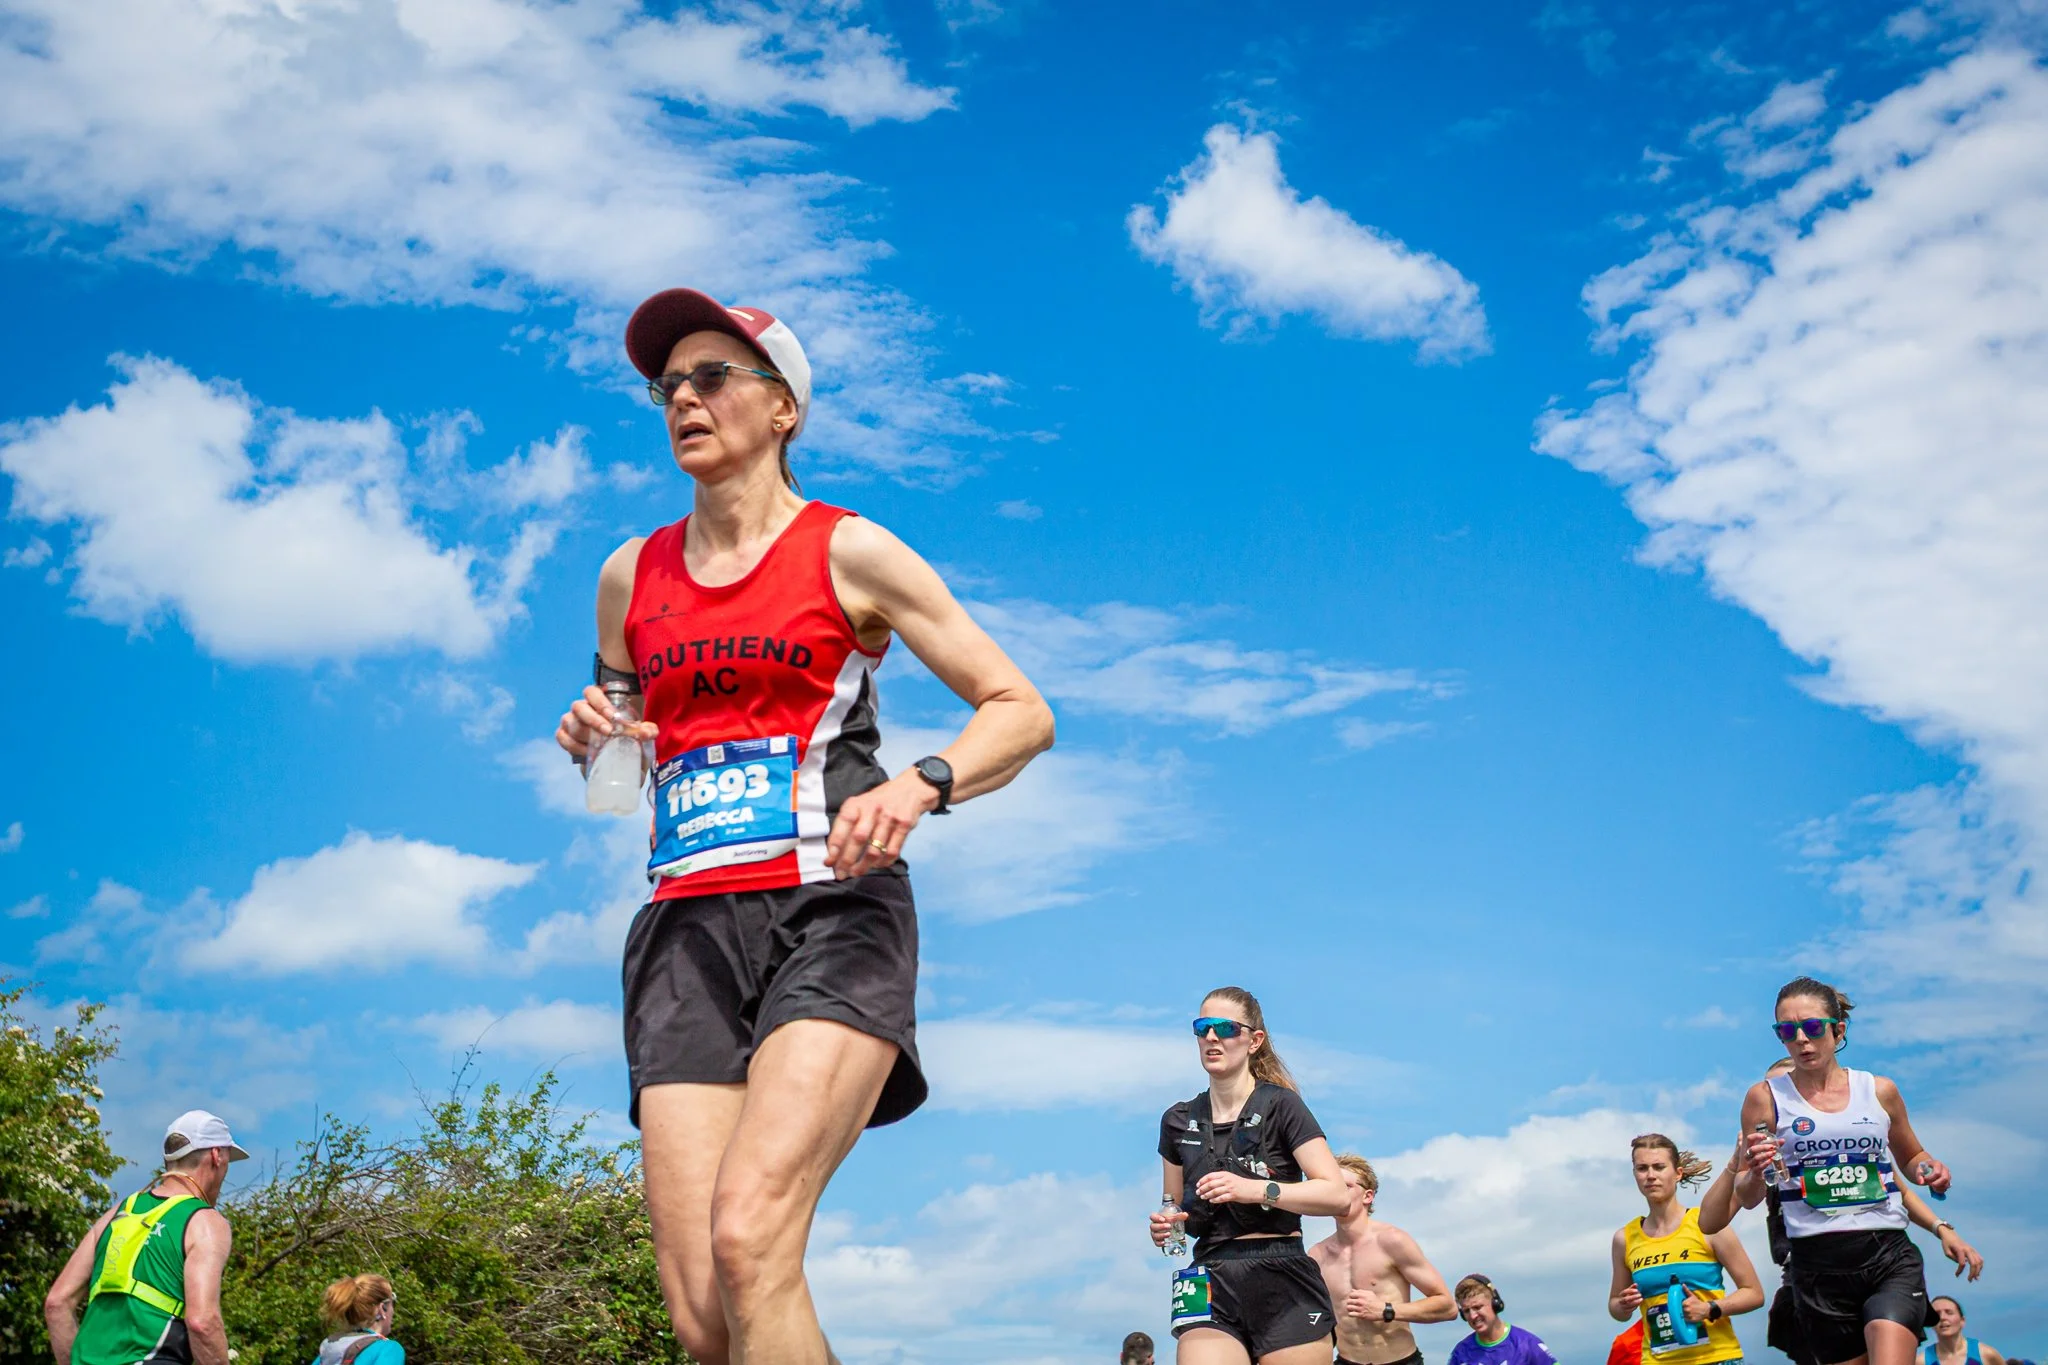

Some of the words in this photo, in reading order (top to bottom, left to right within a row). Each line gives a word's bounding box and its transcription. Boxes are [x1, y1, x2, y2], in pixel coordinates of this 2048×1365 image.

[641, 636, 813, 688] SOUTHEND
[692, 666, 739, 698] AC
[677, 806, 755, 840] REBECCA
[1794, 1137, 1883, 1152] CROYDON
[1814, 1165, 1868, 1186] 6289
[1830, 1186, 1860, 1197] LIANE
[1633, 1252, 1670, 1269] WEST
[1680, 1249, 1690, 1260] 4
[1173, 1279, 1197, 1298] 24
[1656, 1312, 1672, 1328] 63
